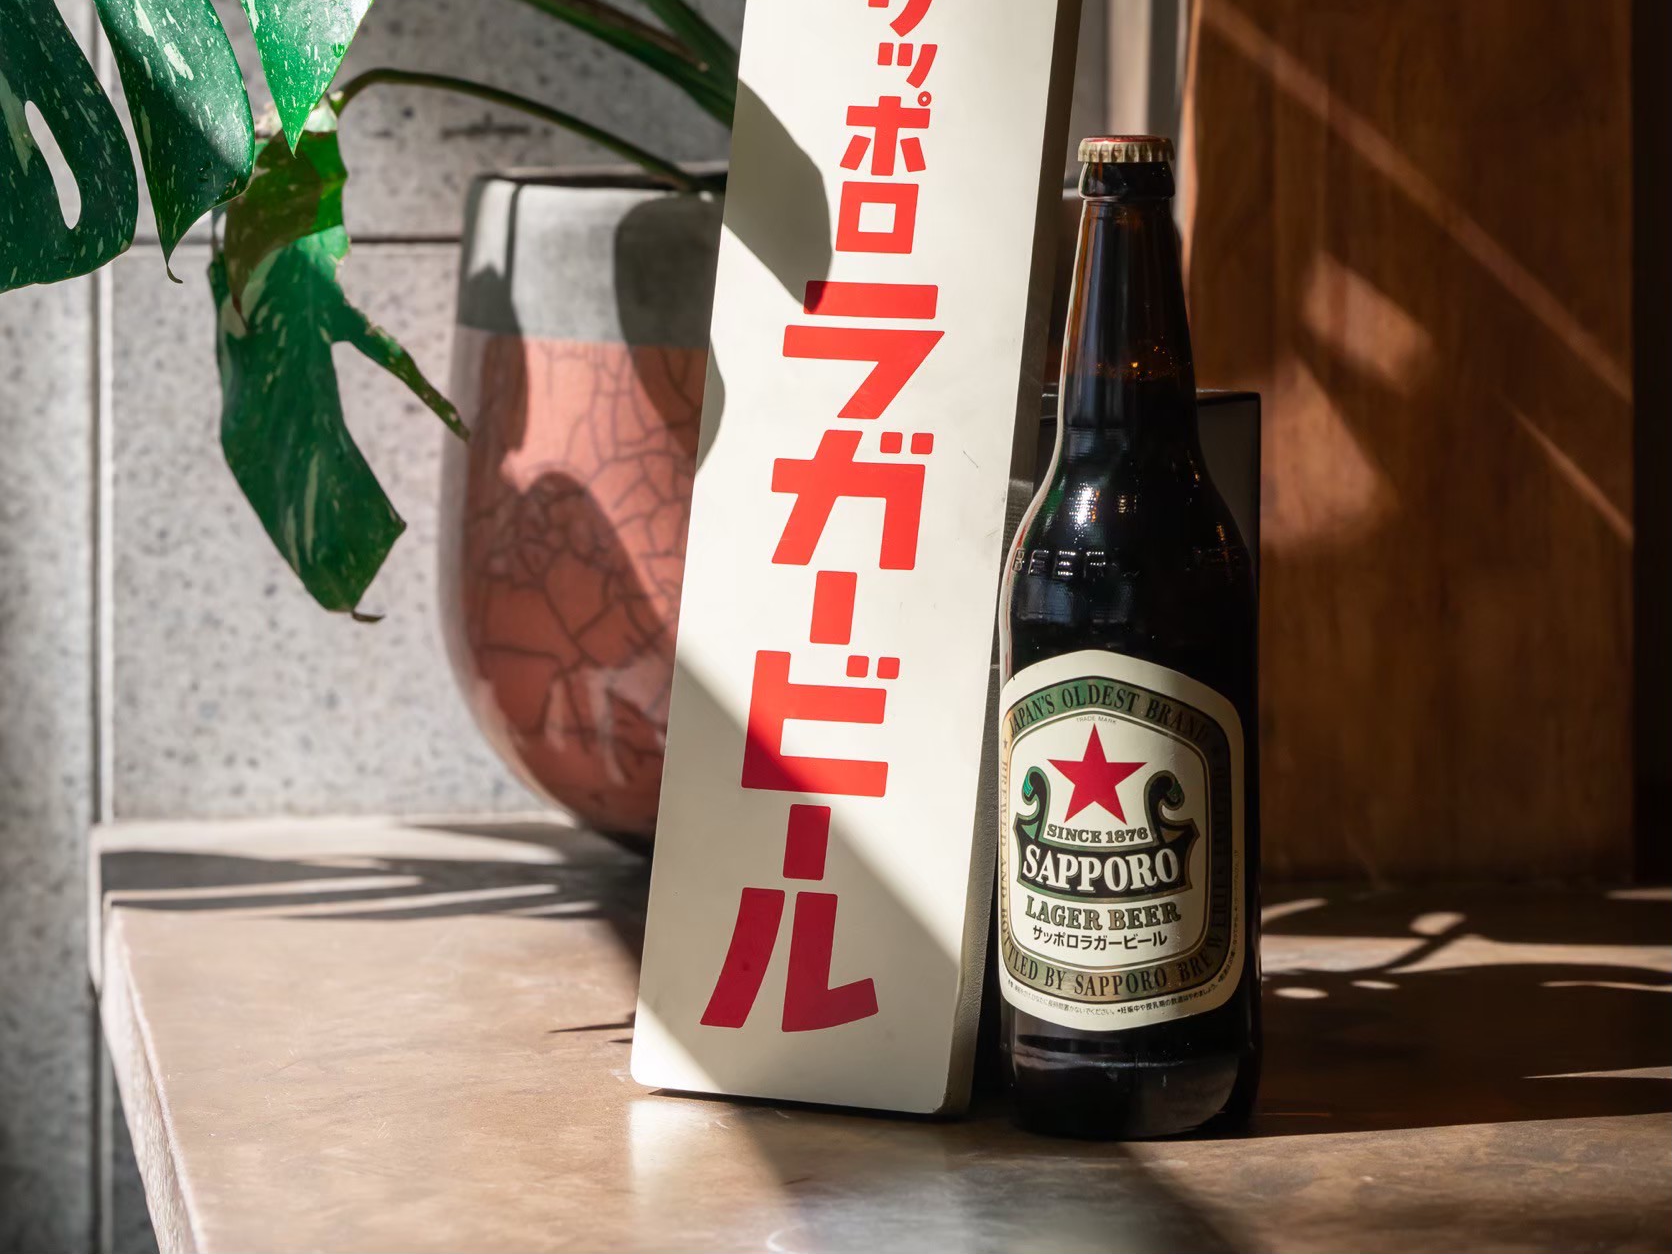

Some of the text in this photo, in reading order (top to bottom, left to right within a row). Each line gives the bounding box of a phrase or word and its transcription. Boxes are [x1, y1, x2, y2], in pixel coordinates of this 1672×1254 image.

[1008, 683, 1210, 741] JAPAN'S OLDEST BRAND
[1076, 715, 1118, 725] TRADE MARK
[1046, 823, 1149, 844] SINCE 1876
[1022, 844, 1180, 893] SAPPORO
[1025, 894, 1182, 931] LAGER BEER
[1001, 907, 1039, 981] BOTTLED
[1043, 966, 1067, 991] BY
[1074, 965, 1168, 997] SAPPORO
[1032, 925, 1168, 951] サッポロラガービール
